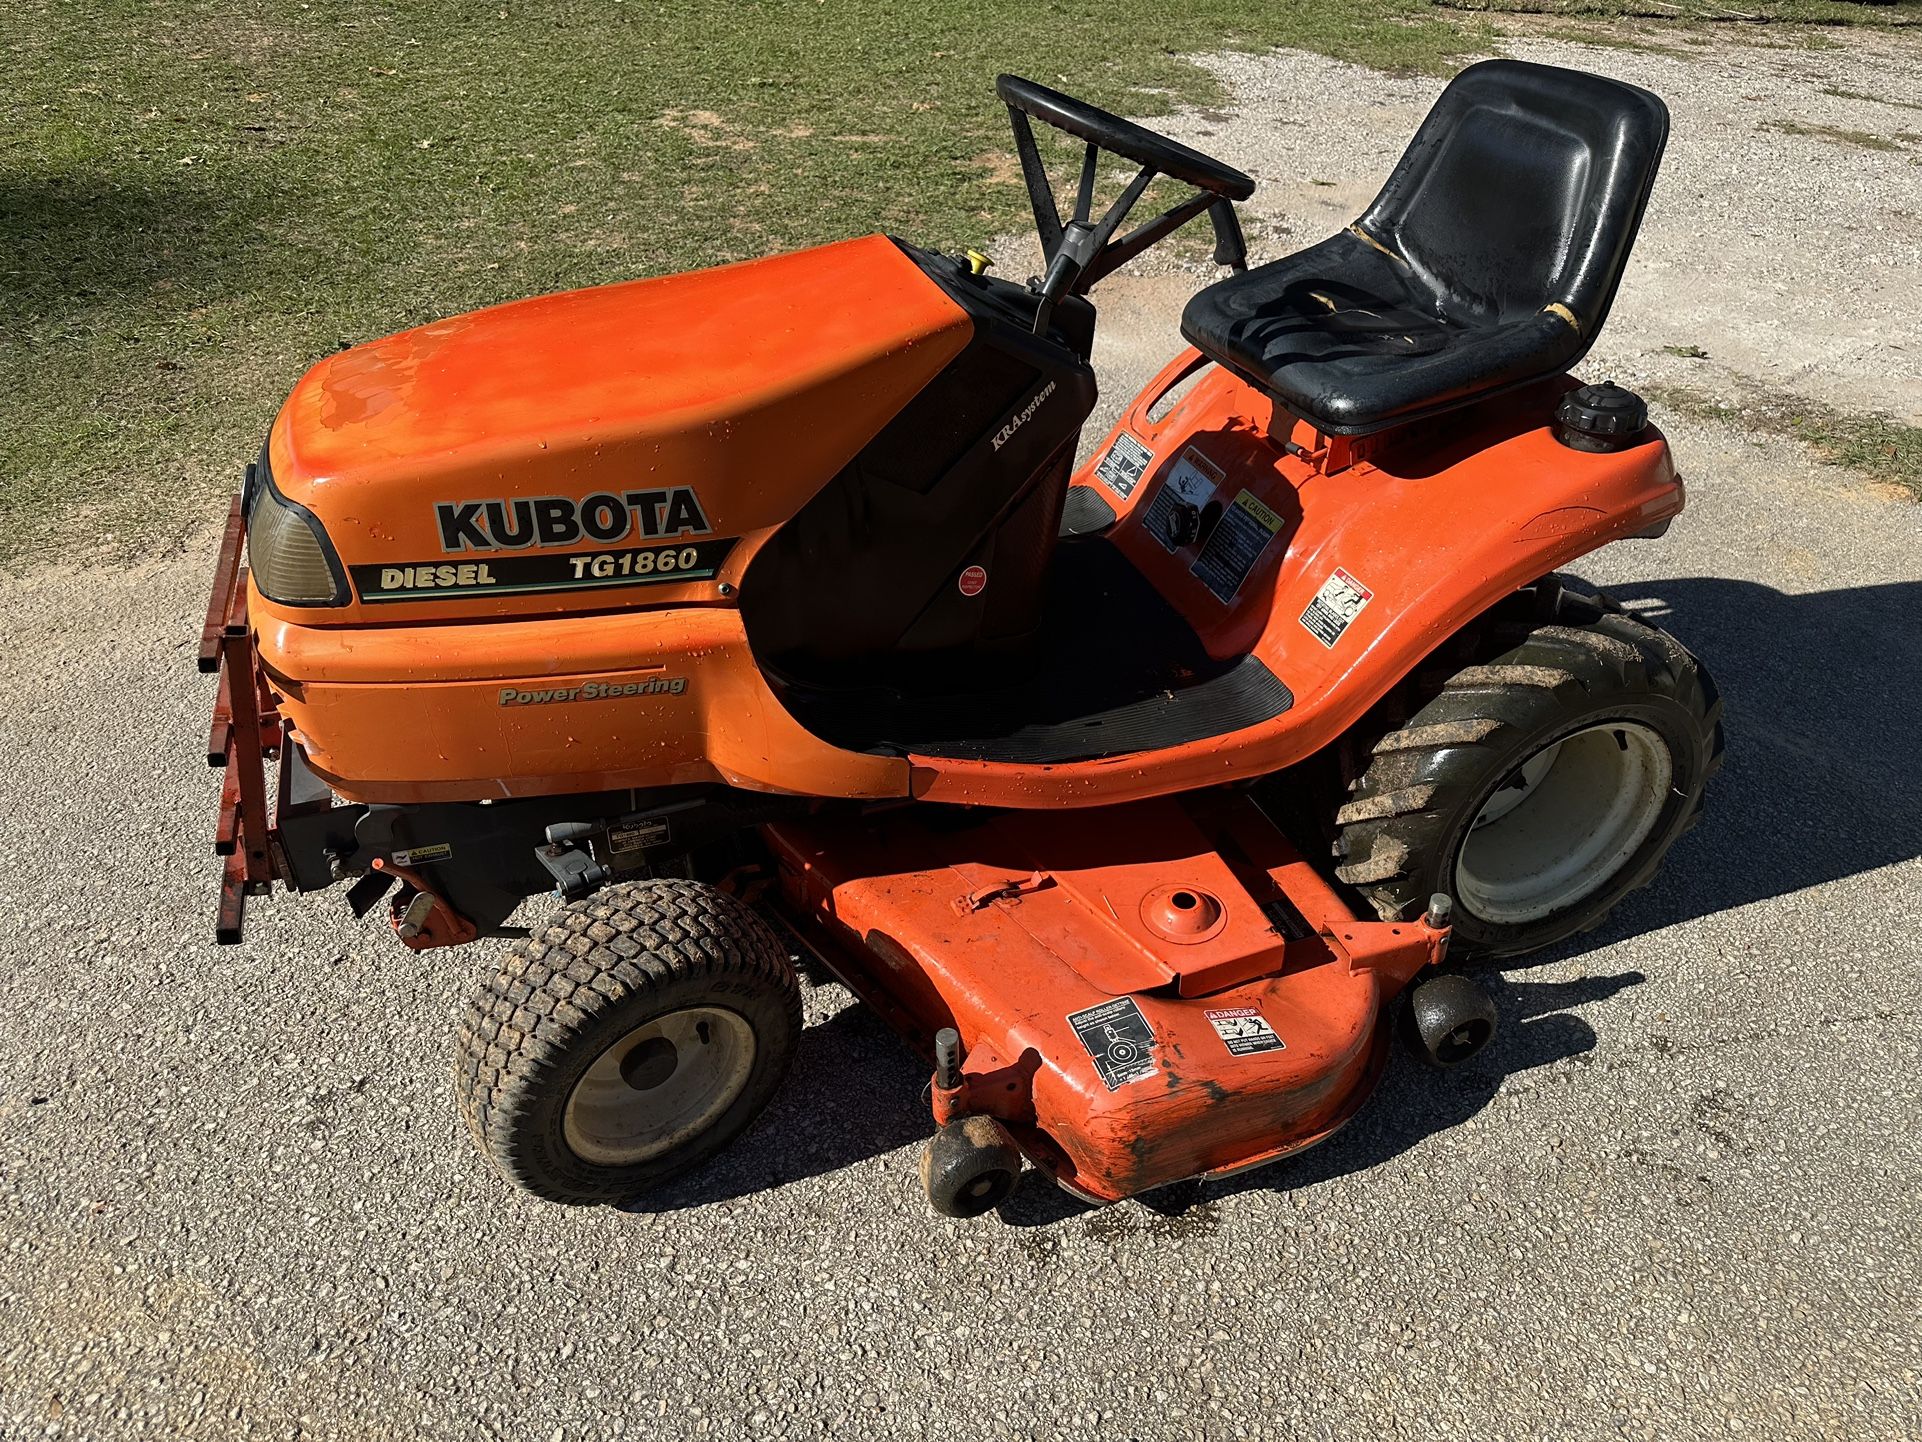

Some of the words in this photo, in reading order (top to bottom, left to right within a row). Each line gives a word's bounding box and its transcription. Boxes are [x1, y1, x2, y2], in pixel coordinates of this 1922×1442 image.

[990, 379, 1057, 452] KRAsystem
[435, 486, 712, 551] KUBOTA
[1248, 501, 1274, 527] CAUTION
[380, 563, 496, 590] DIESEL
[569, 547, 698, 579] TG1860
[1346, 576, 1366, 595] DANGER
[418, 846, 446, 854] CAUTION
[1216, 1008, 1256, 1018] DANGER
